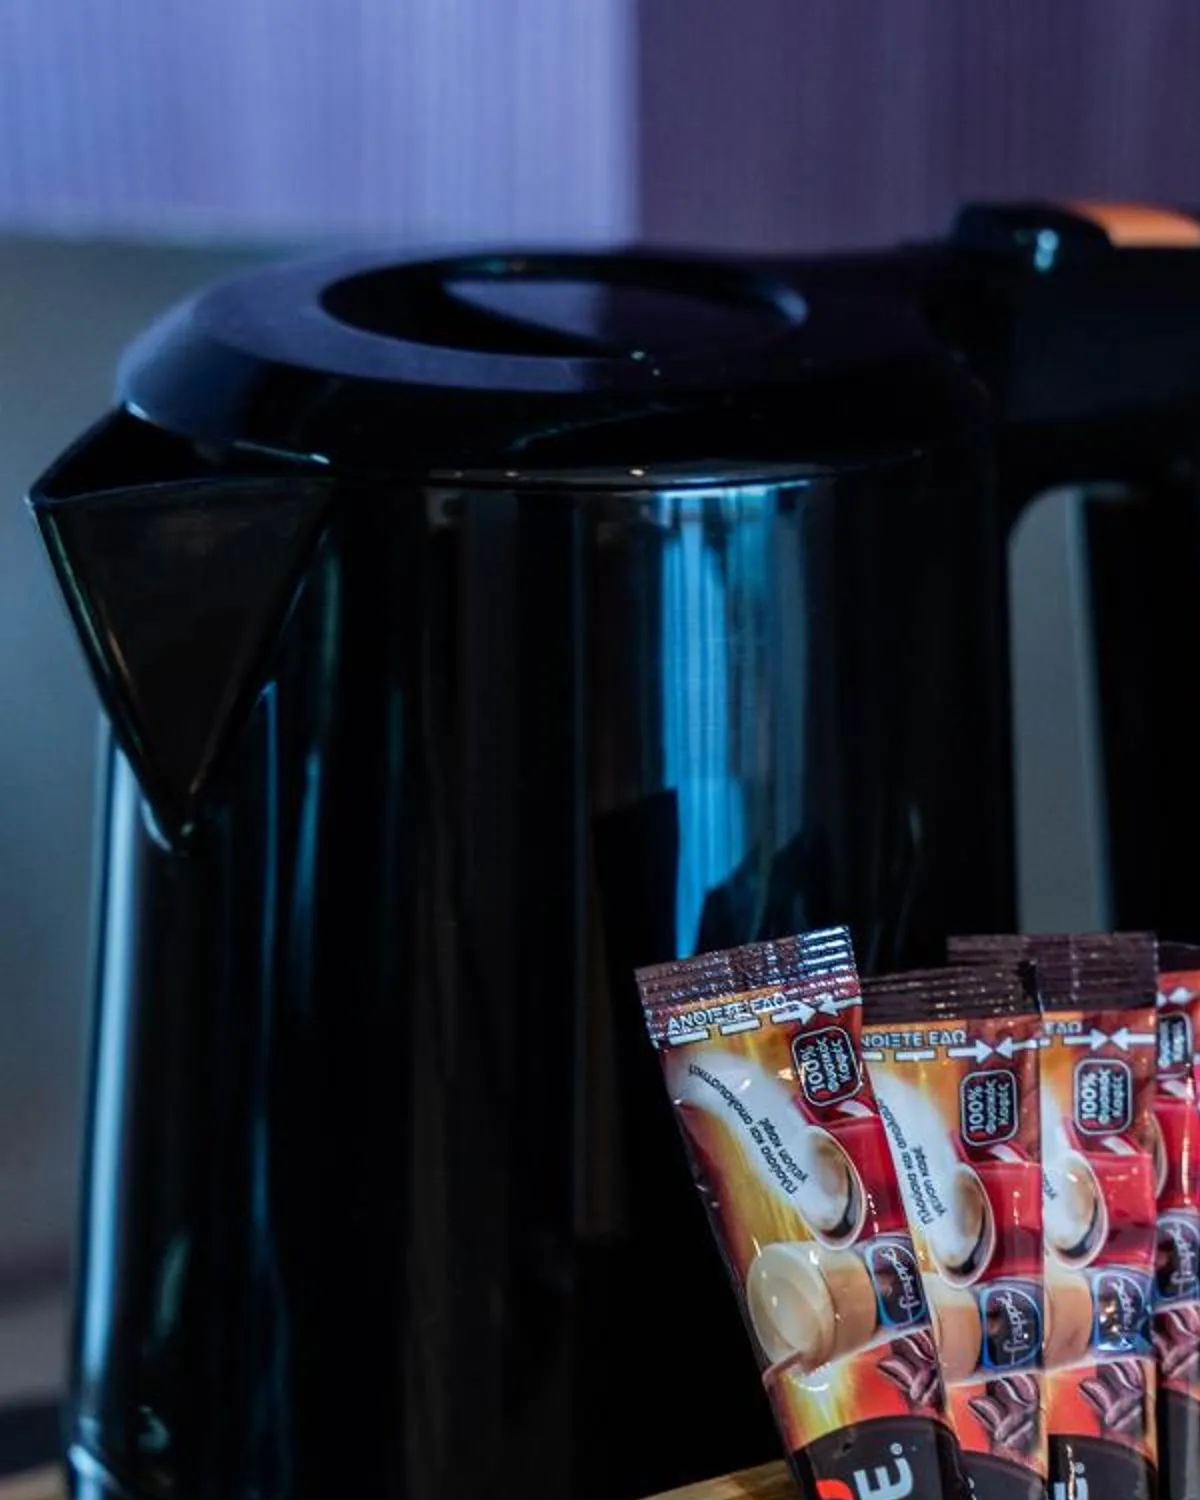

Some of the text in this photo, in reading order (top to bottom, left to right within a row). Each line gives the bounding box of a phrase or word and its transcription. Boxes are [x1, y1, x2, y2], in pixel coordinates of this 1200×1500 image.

[929, 1030, 967, 1045] ΕΔΩ
[801, 1046, 824, 1093] 100%
[968, 1086, 985, 1132] 100%
[1081, 1071, 1097, 1121] 100%
[749, 1126, 764, 1146] και
